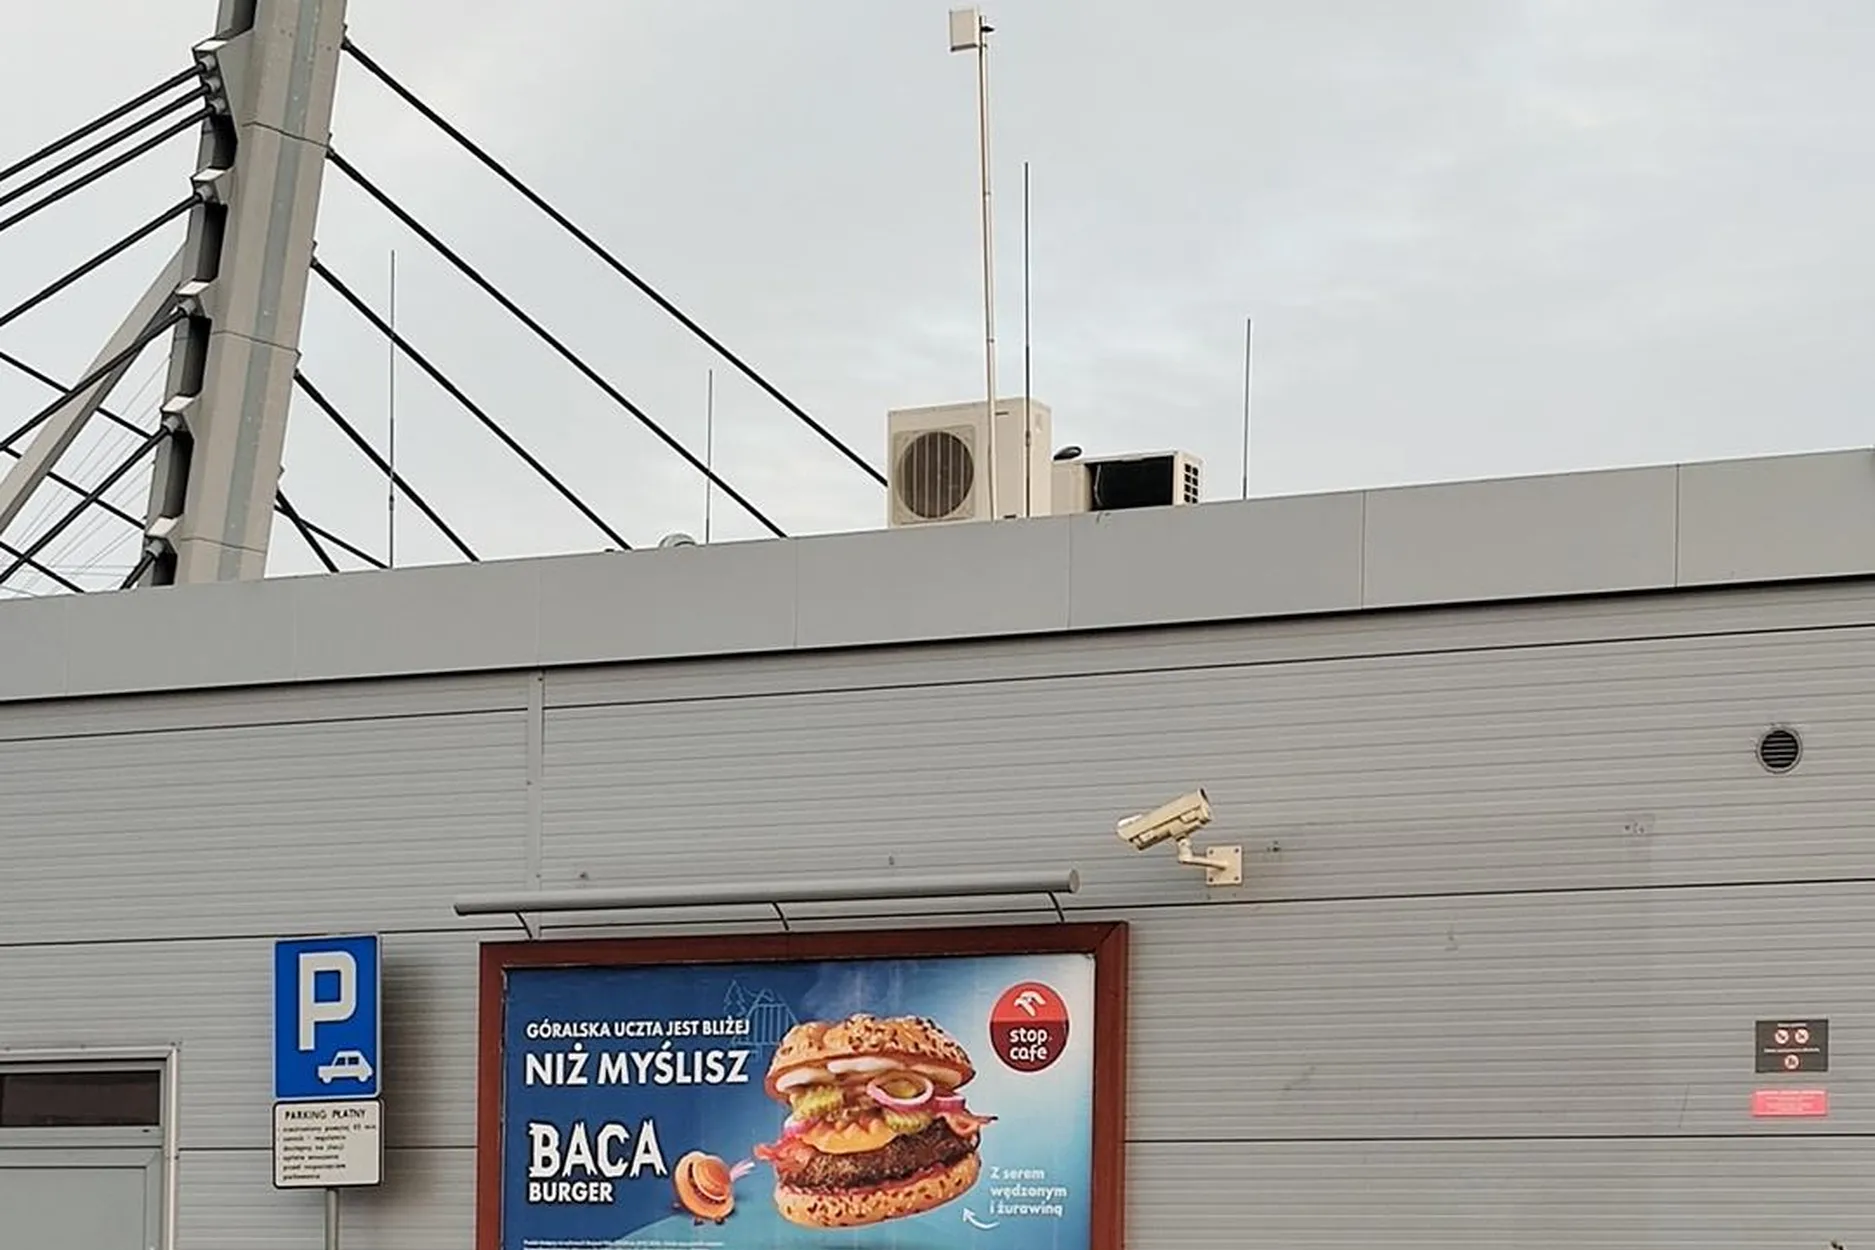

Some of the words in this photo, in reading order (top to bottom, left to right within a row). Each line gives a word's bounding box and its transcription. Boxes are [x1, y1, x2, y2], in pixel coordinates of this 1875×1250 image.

[299, 951, 357, 1050] P
[526, 1018, 611, 1039] GÓRALSKA
[614, 1020, 665, 1037] UCZTA
[665, 1019, 700, 1037] JEST
[702, 1015, 750, 1036] BLIŻEJ
[1009, 1027, 1048, 1045] stop
[1009, 1044, 1048, 1062] cafe
[525, 1043, 589, 1085] NIŻ
[597, 1040, 750, 1085] MYŚLISZ
[285, 1109, 327, 1120] PARKING
[332, 1108, 367, 1118] PŁATNY
[528, 1119, 668, 1178] BACA
[990, 1166, 1001, 1179] Z
[1003, 1168, 1045, 1180] serem
[528, 1181, 614, 1202] BURGER
[990, 1184, 1067, 1200] wędzonym
[990, 1200, 994, 1213] i
[998, 1201, 1064, 1217] żurawiną
